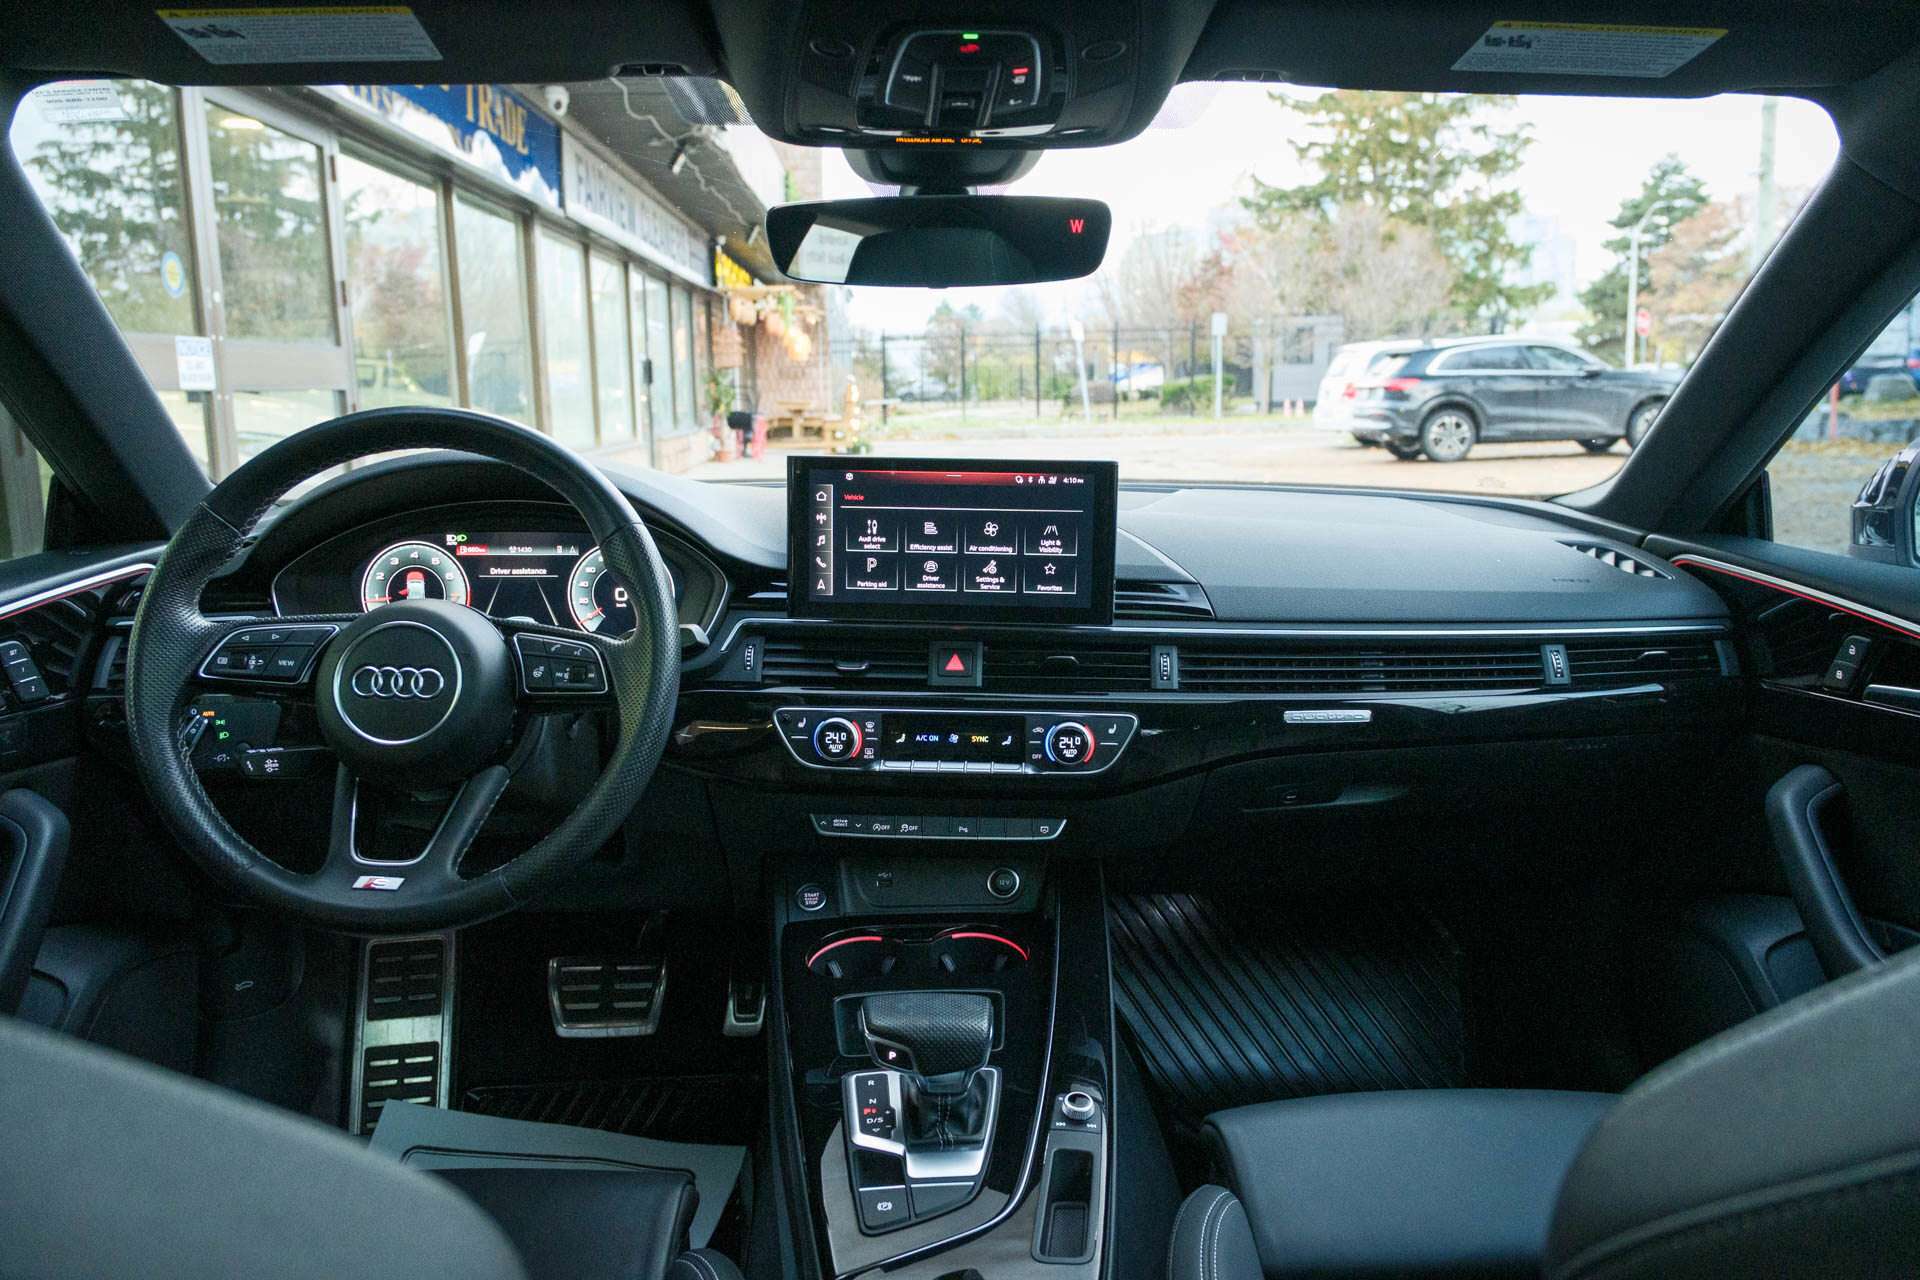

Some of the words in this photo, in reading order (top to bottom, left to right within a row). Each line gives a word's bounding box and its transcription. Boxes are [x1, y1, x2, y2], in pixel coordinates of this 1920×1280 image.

[465, 84, 529, 155] TRADE
[1069, 218, 1085, 234] W
[1040, 539, 1054, 547] Light
[909, 543, 936, 552] Efficiency
[978, 545, 1013, 553] conditioning
[1039, 546, 1063, 554] Visibility
[409, 551, 419, 559] 4
[390, 557, 399, 565] 3
[375, 571, 385, 580] 2
[922, 574, 940, 582] Driver
[856, 580, 877, 588] Parking
[975, 576, 999, 584] Settings
[825, 731, 847, 744] 24.0
[915, 734, 928, 742] A/C
[928, 734, 939, 742] ON
[971, 735, 989, 743] SYNC
[1059, 736, 1081, 749] 24.0
[889, 1050, 897, 1060] P
[868, 1097, 877, 1105] N
